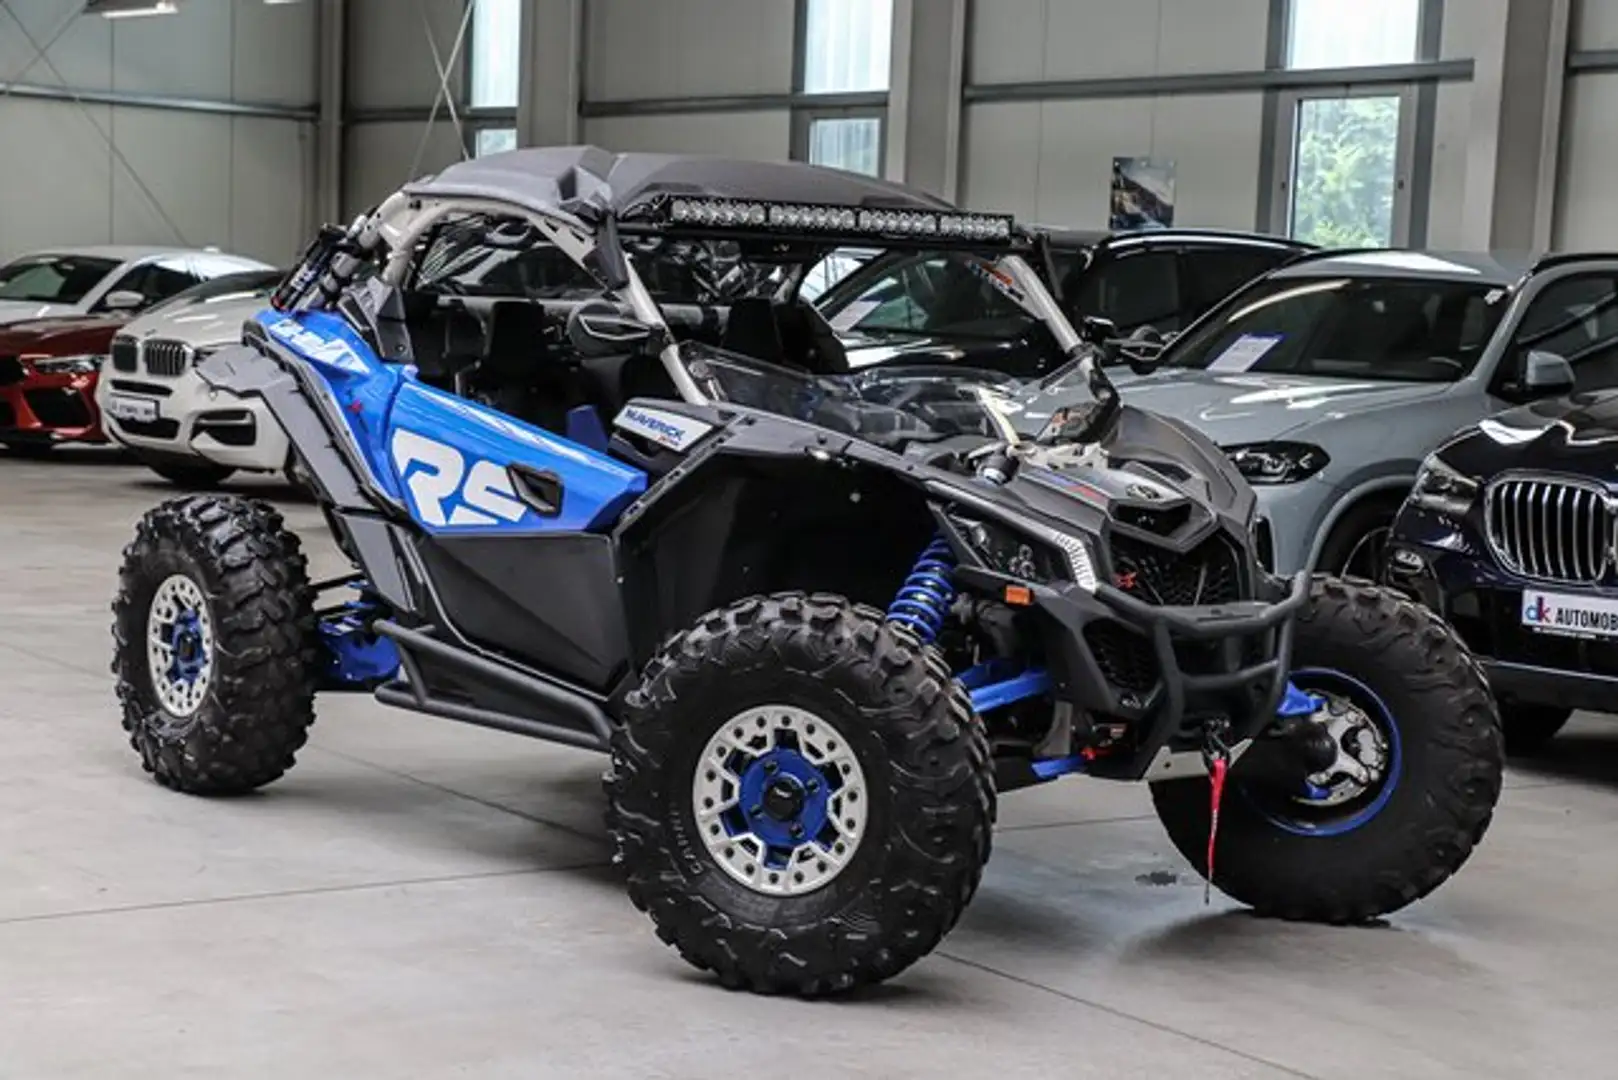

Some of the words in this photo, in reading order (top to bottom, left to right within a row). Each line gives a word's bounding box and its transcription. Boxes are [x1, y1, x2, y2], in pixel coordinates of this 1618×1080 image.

[624, 408, 685, 441] MAVERICK
[391, 427, 528, 527] RS
[1525, 595, 1551, 623] dk
